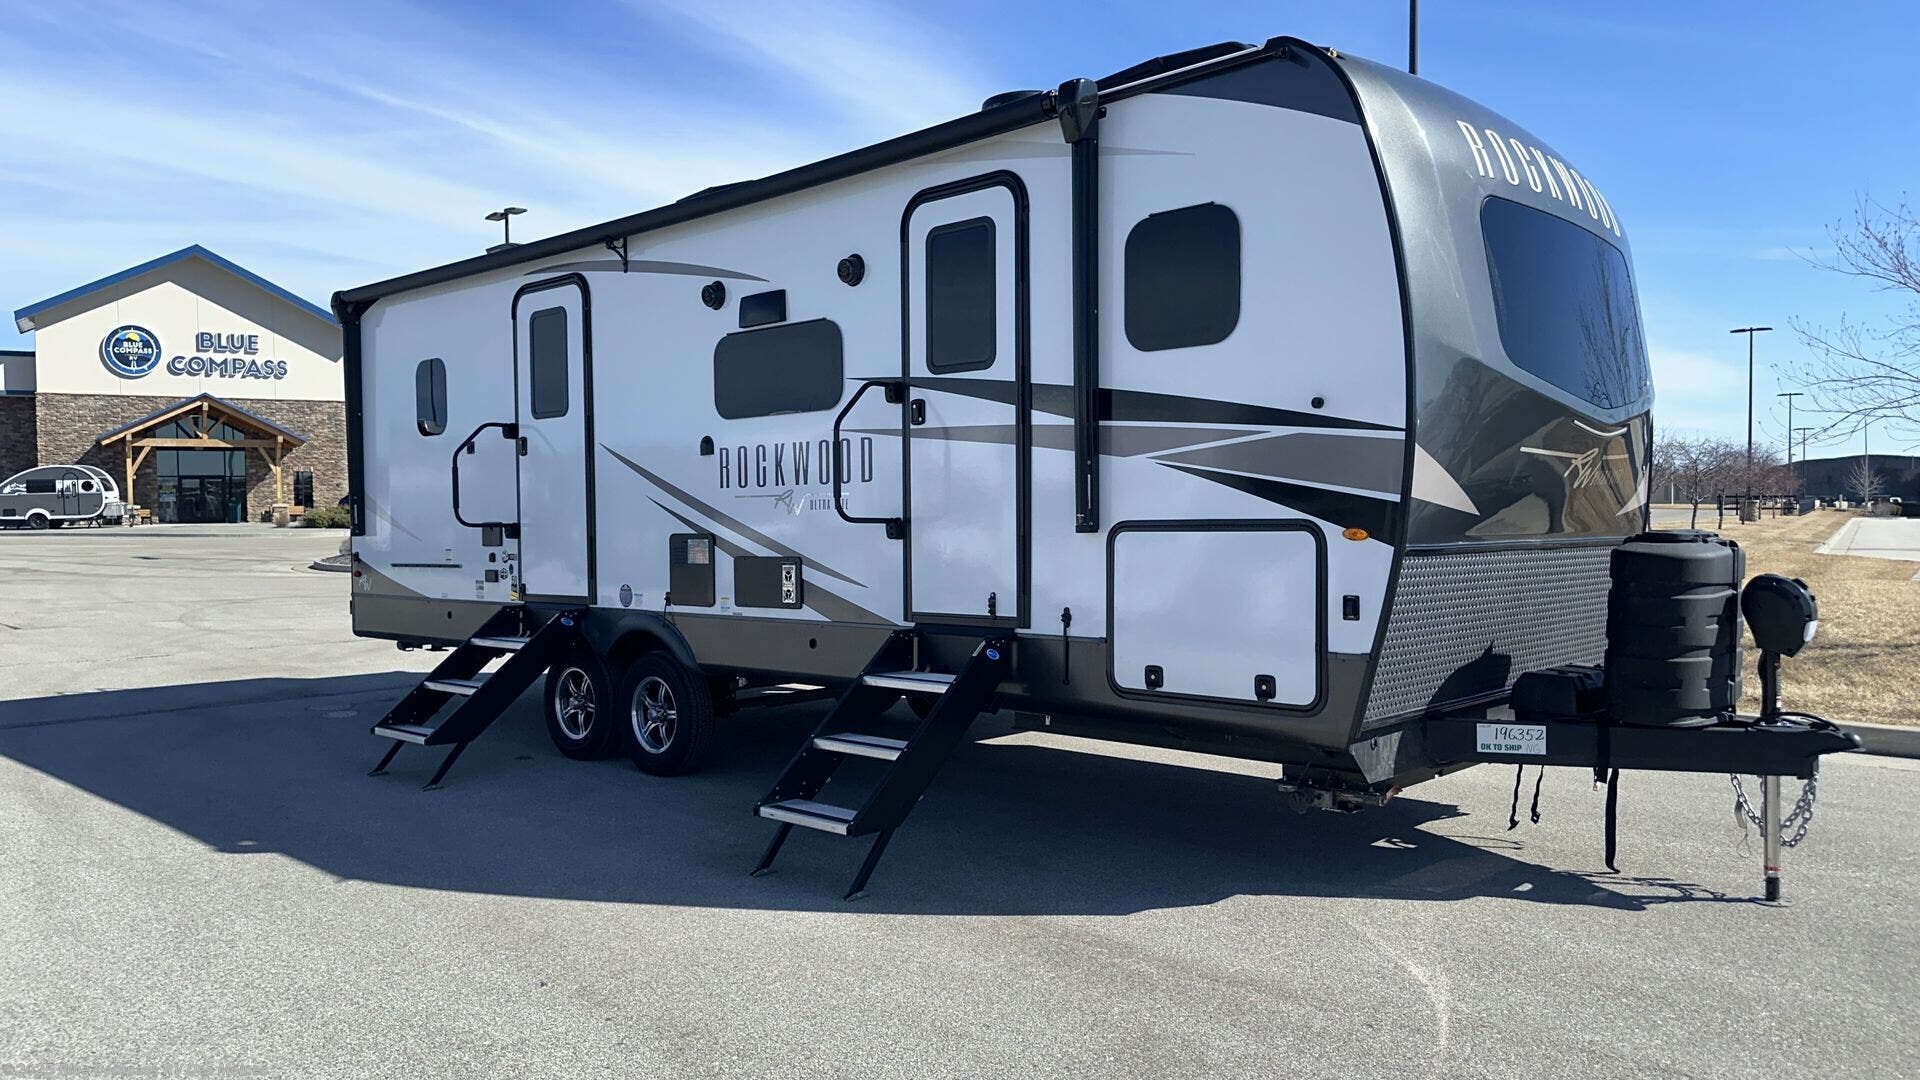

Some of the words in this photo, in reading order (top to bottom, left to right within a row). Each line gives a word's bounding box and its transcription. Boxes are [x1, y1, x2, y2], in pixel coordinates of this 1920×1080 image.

[1456, 120, 1621, 237] ROCKWOOD
[196, 332, 259, 355] BLUE
[167, 356, 287, 380] COMPASS
[719, 437, 873, 489] ROCKWOOD
[1495, 727, 1545, 741] 196352
[1493, 743, 1503, 751] TO
